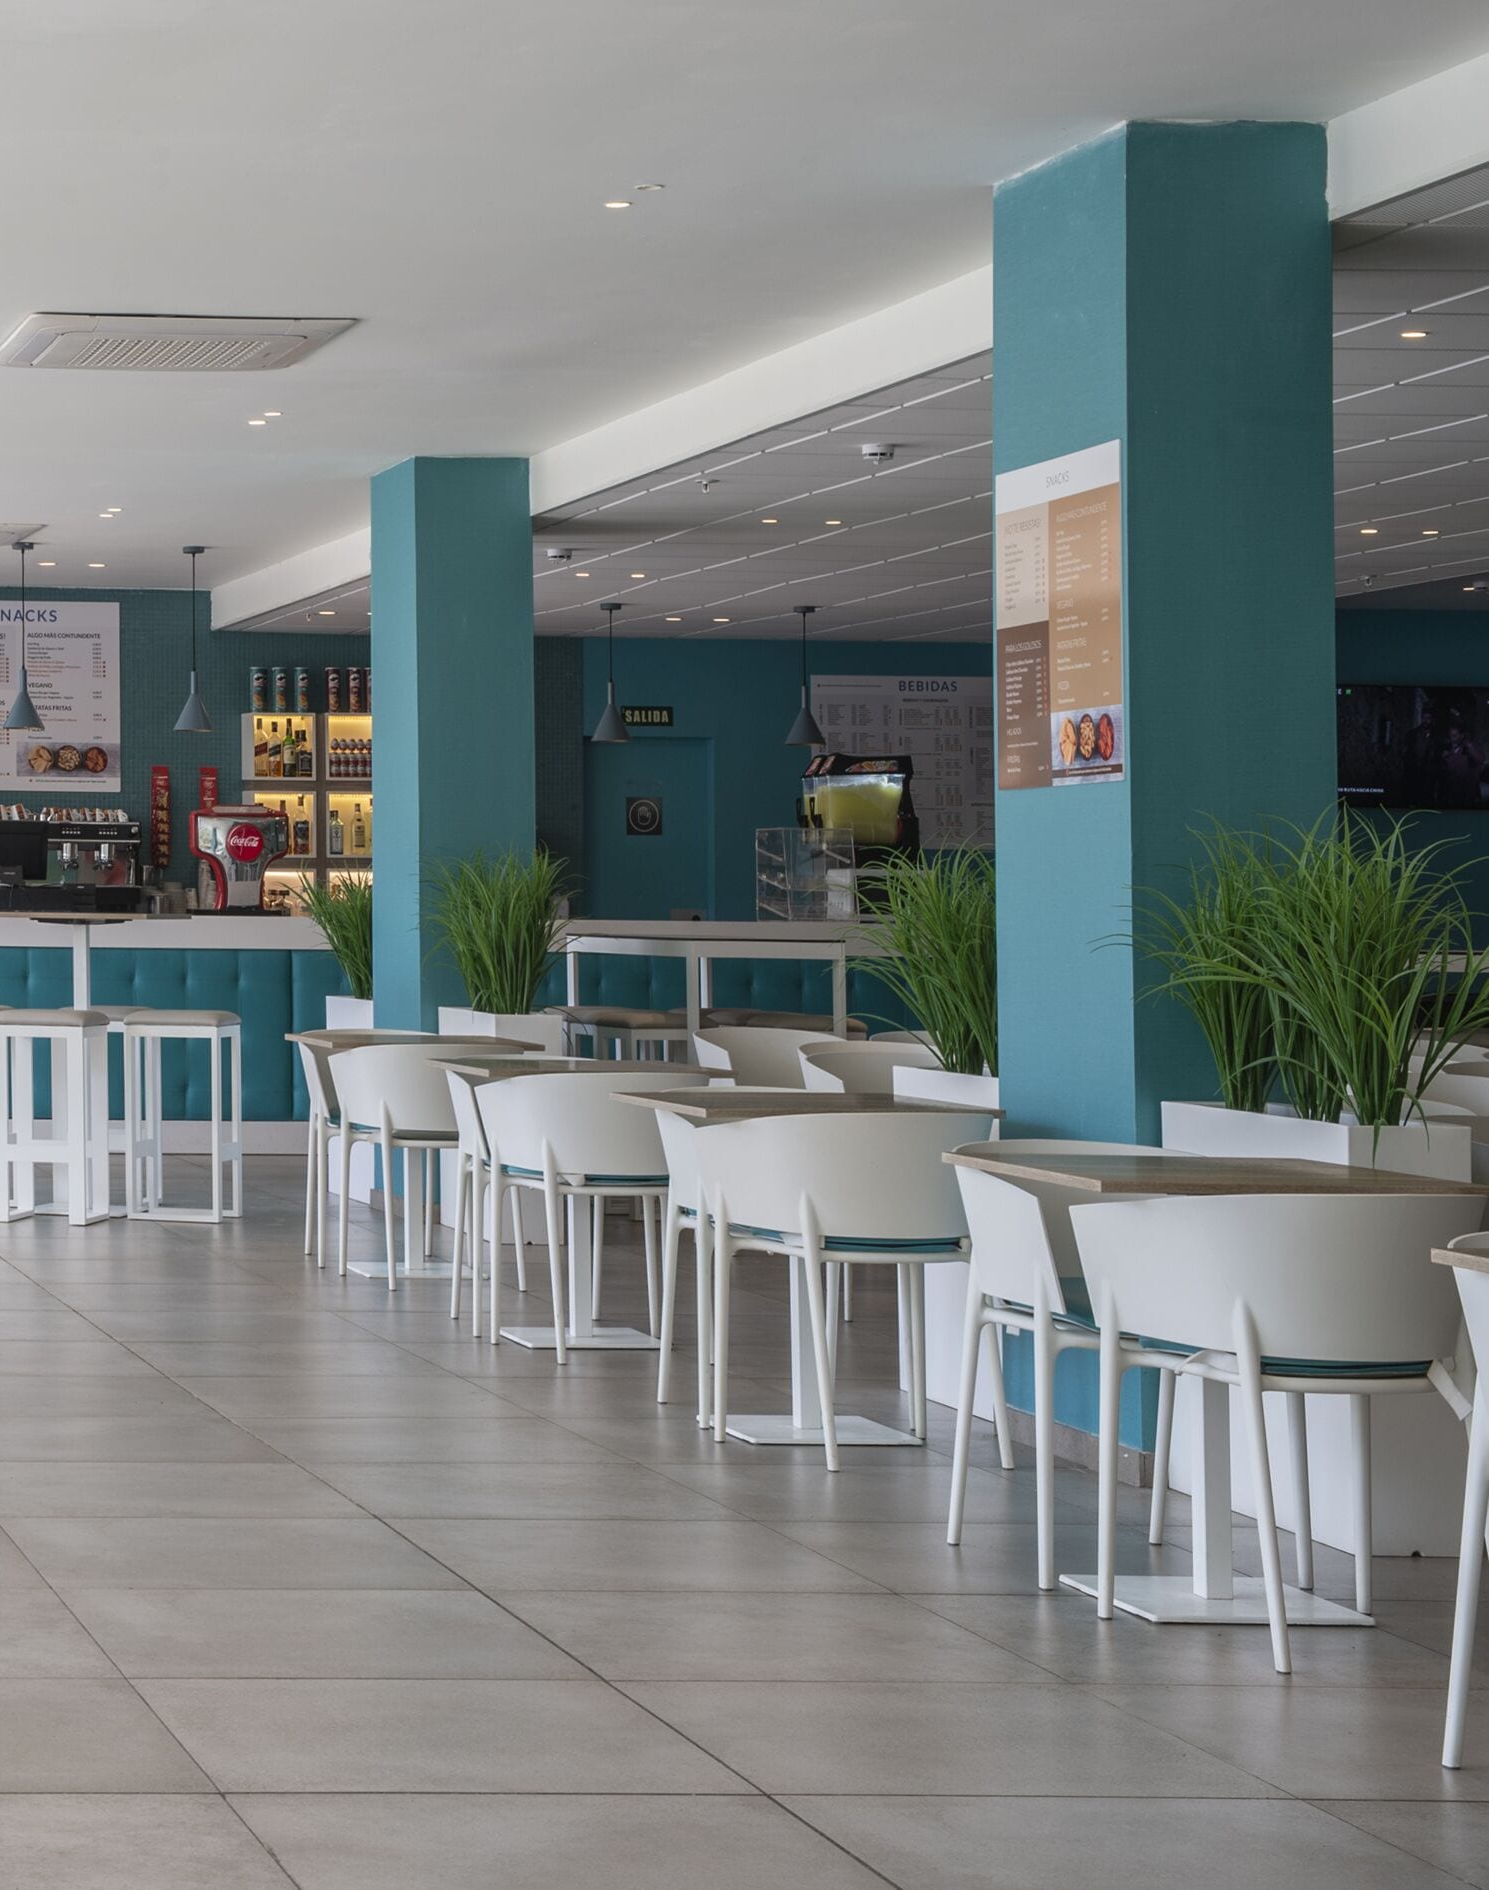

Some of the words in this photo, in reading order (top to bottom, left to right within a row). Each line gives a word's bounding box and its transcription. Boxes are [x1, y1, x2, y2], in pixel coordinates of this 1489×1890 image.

[1046, 471, 1070, 488] SNACKS
[898, 680, 958, 692] BEBIDAS
[625, 710, 669, 723] SALIDA
